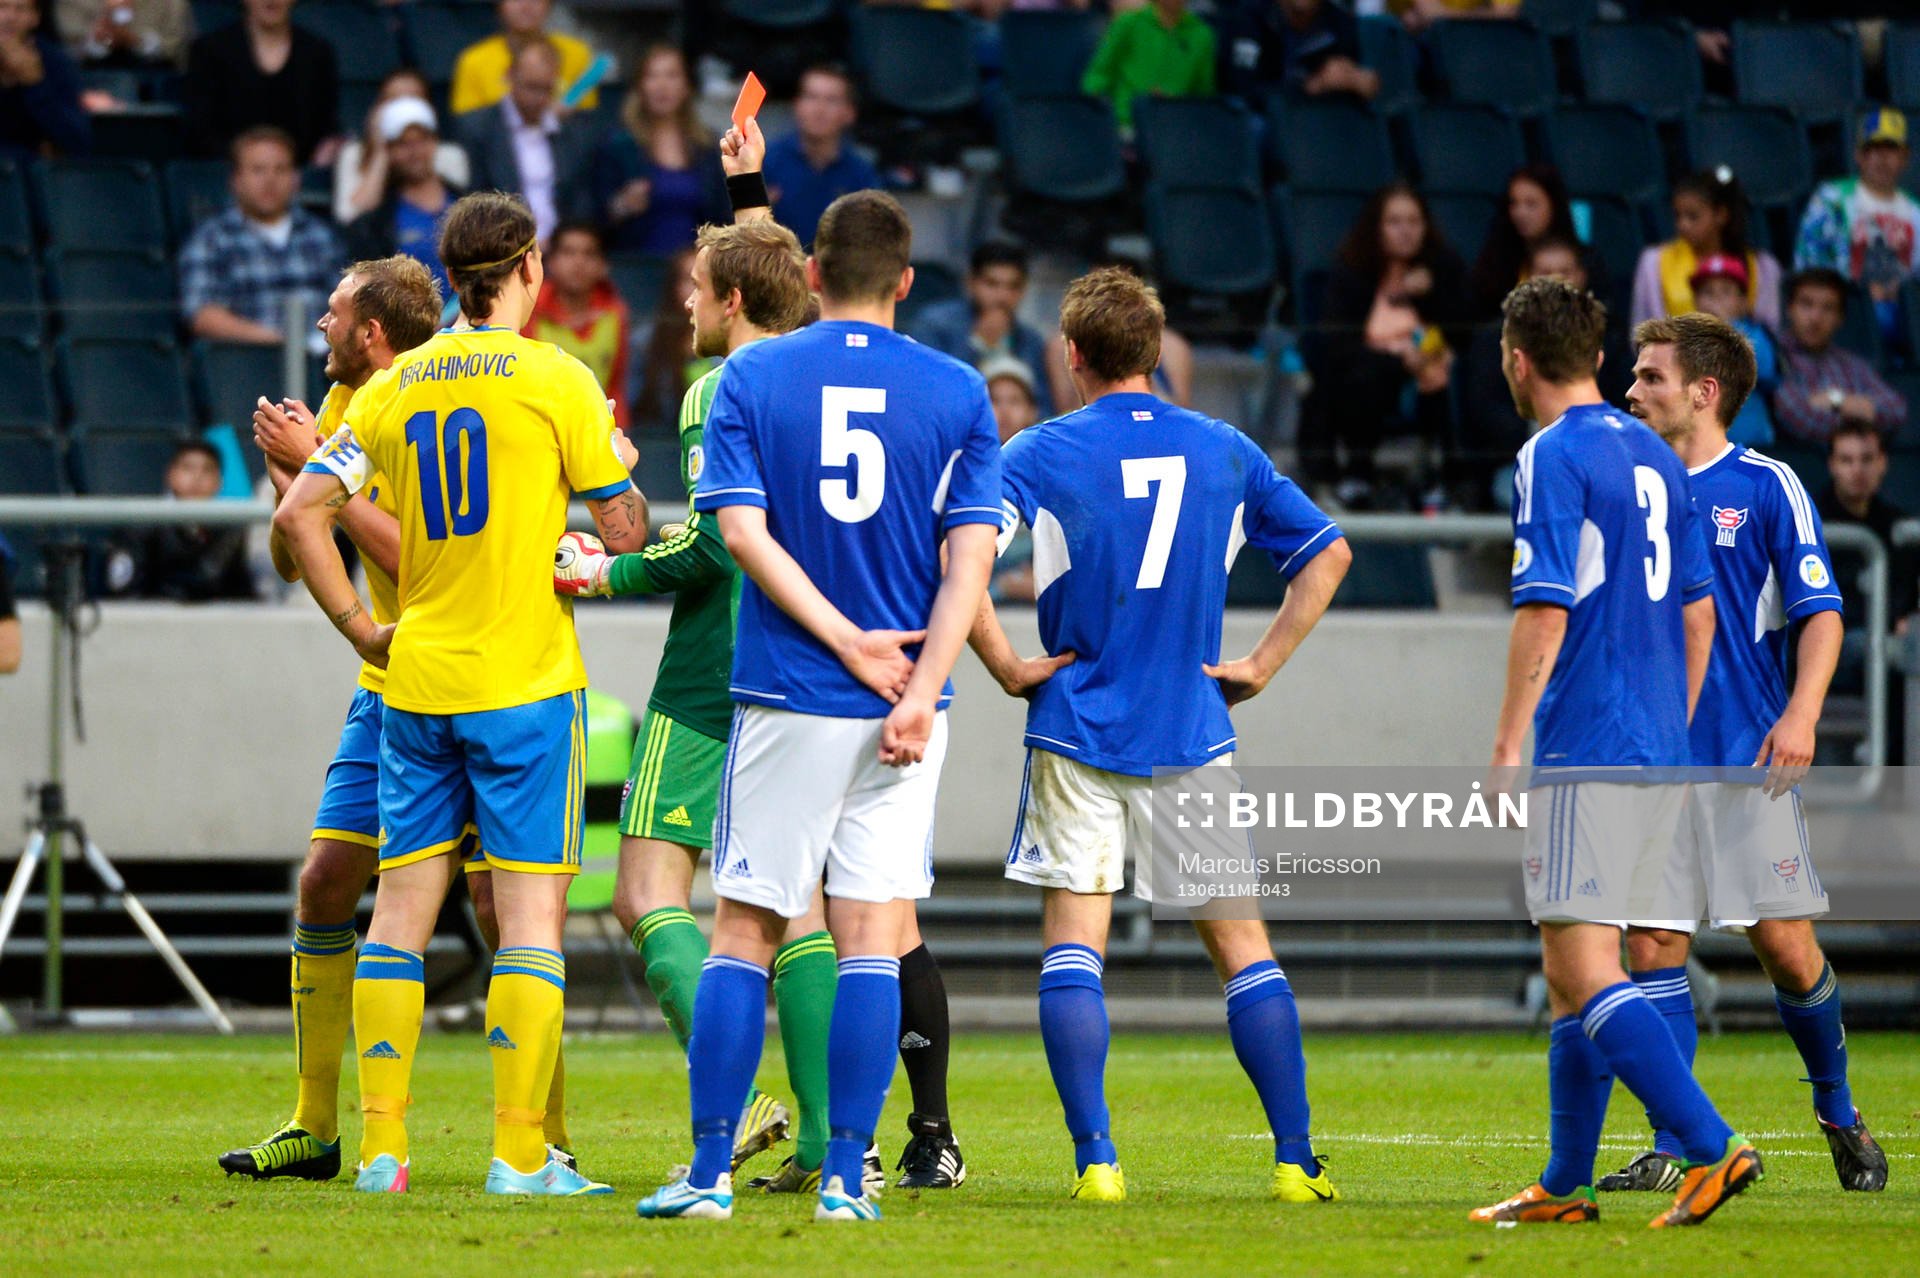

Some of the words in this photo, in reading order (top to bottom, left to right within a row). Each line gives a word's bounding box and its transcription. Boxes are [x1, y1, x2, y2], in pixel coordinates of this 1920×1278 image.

[399, 352, 517, 391] IBRAHIMOVIĆ
[404, 406, 490, 541] 10
[818, 385, 888, 525] 5
[1120, 455, 1188, 590] 7
[1633, 465, 1672, 602] 3
